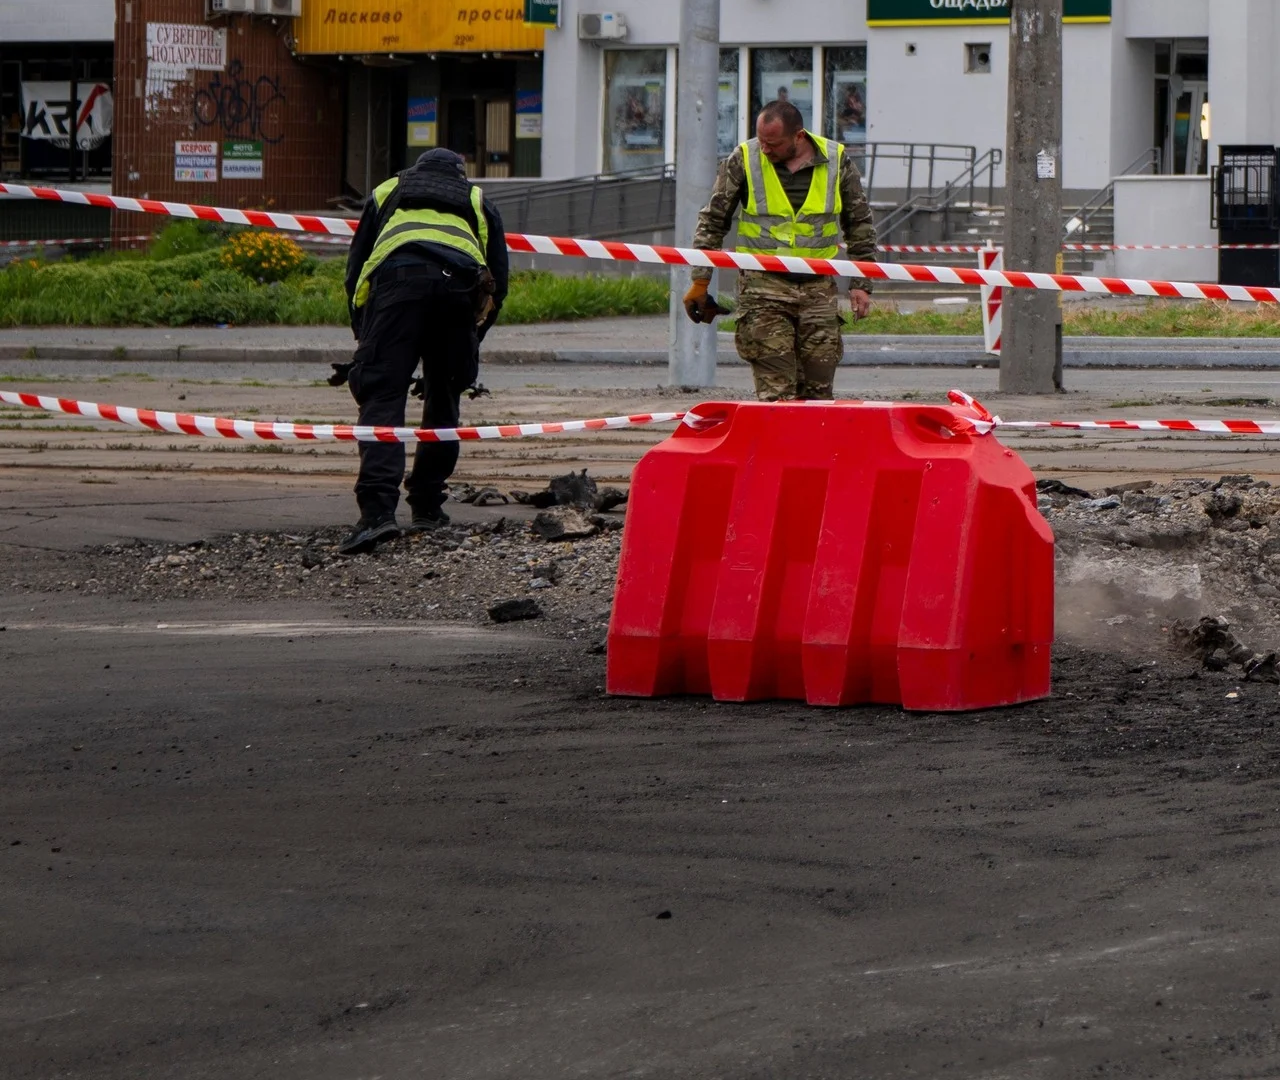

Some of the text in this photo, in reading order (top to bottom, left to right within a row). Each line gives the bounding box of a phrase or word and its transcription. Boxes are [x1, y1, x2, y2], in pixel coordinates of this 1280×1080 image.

[324, 9, 403, 24] Ласкаво
[152, 45, 222, 65] ПОДАРУНКИ
[180, 144, 212, 152] КСЕРОКС
[232, 144, 253, 152] ФОТО
